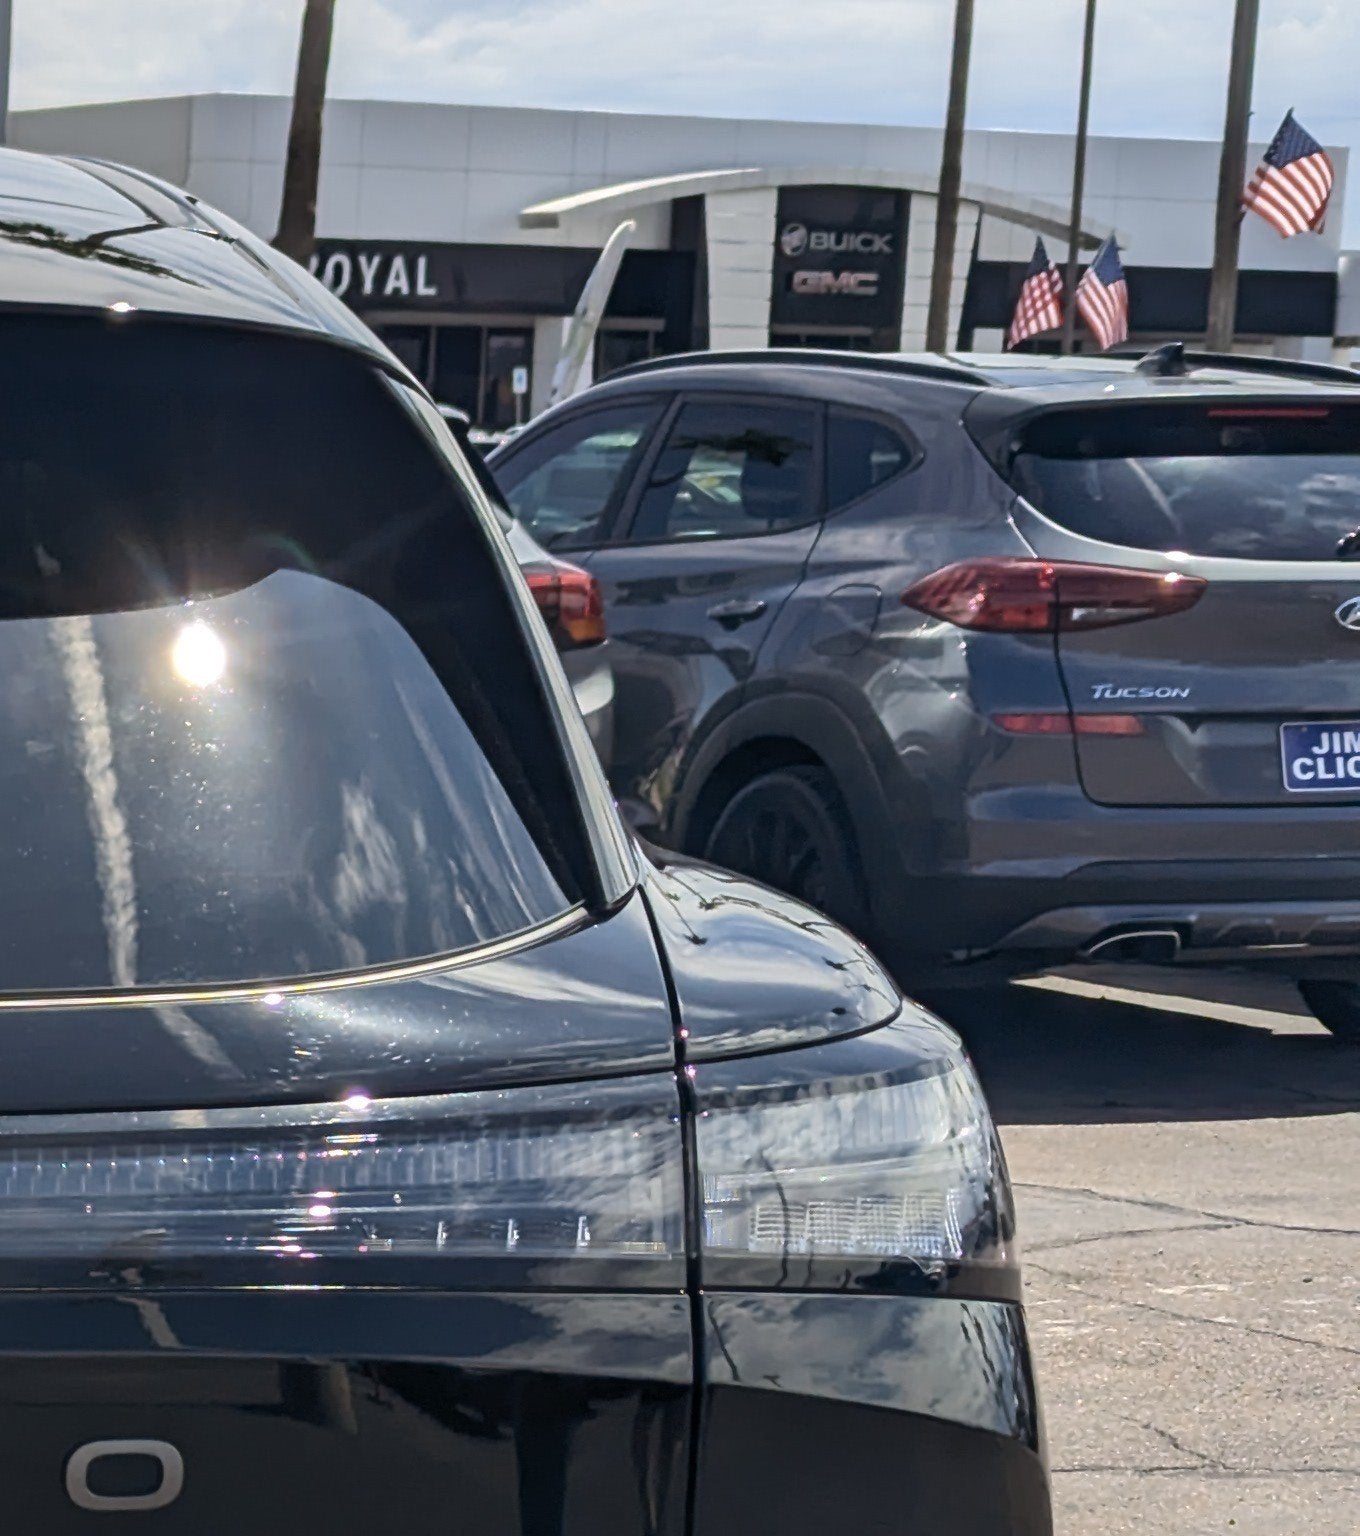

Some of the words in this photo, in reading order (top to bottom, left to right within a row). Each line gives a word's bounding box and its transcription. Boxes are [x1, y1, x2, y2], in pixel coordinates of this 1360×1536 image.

[809, 231, 893, 254] BUICK
[308, 253, 439, 298] OYAL
[792, 271, 879, 295] GMC
